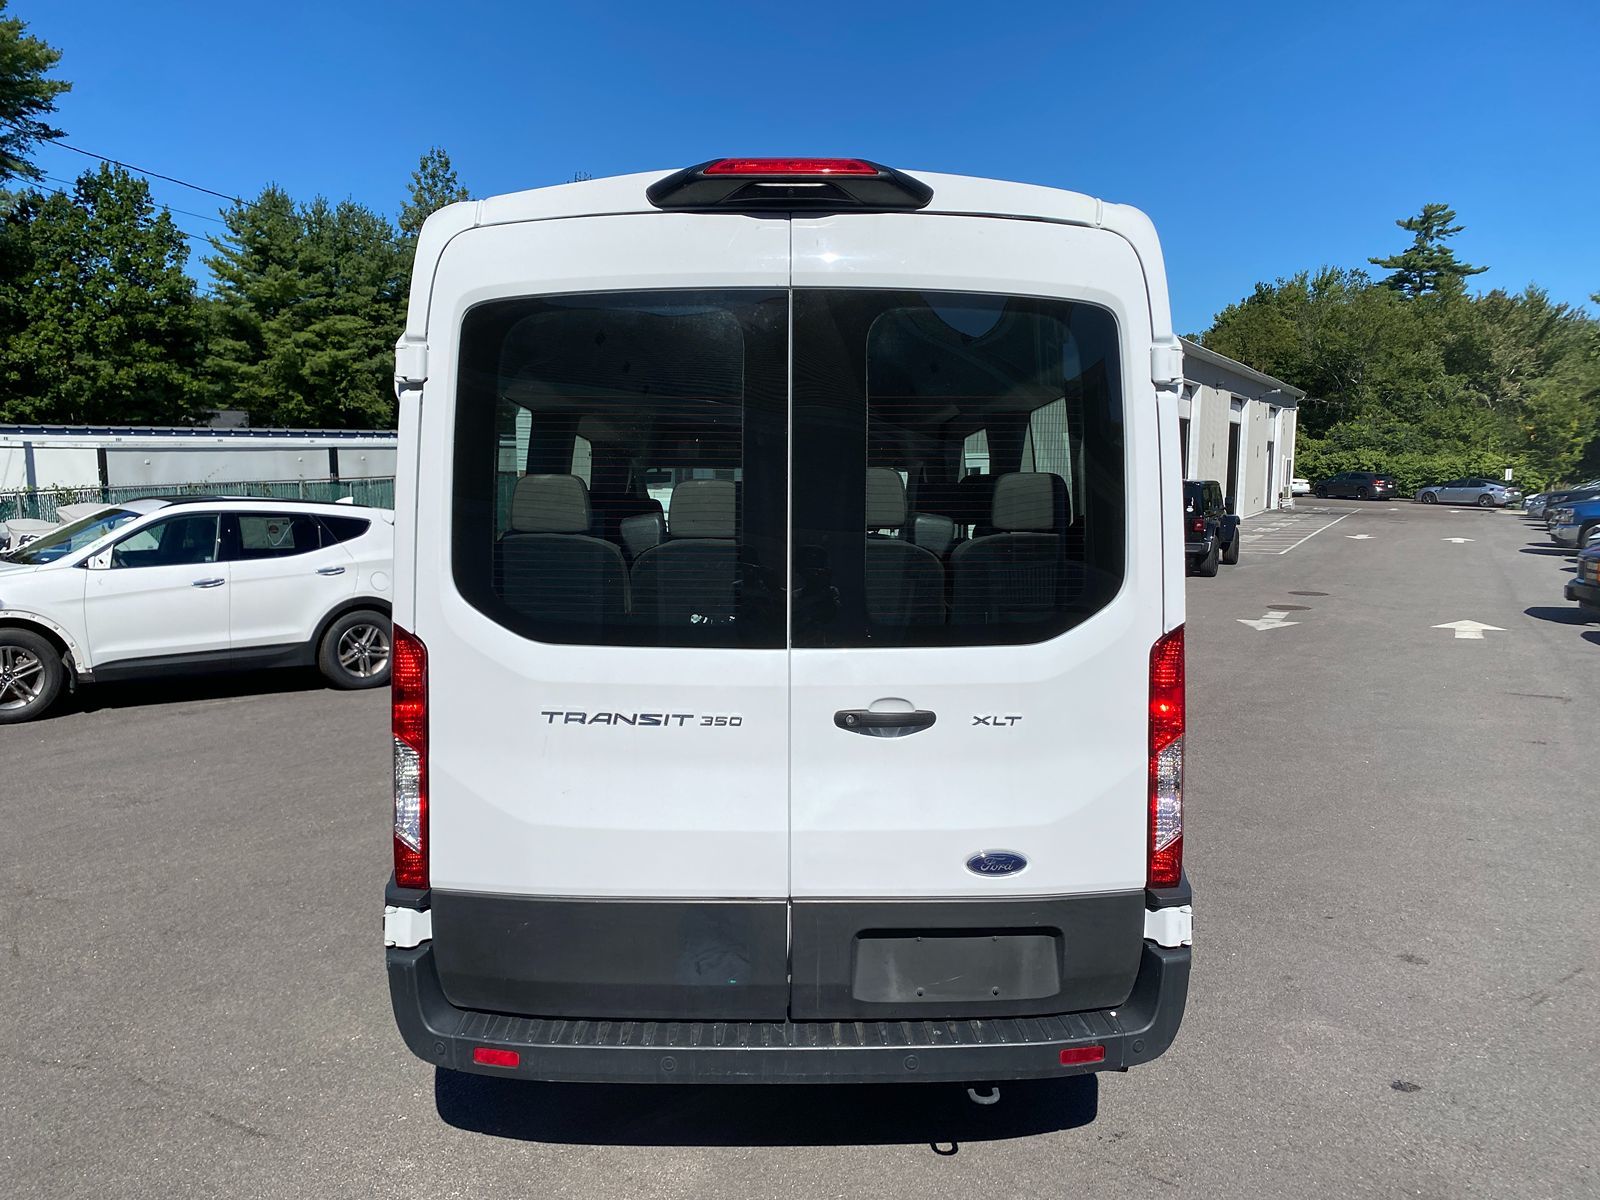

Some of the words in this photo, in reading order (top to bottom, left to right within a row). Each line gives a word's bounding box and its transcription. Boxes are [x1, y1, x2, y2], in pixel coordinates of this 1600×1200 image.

[541, 711, 694, 727] TRANSIT
[700, 715, 743, 727] 350
[971, 715, 1022, 727] XLT
[980, 856, 1015, 871] Ford
